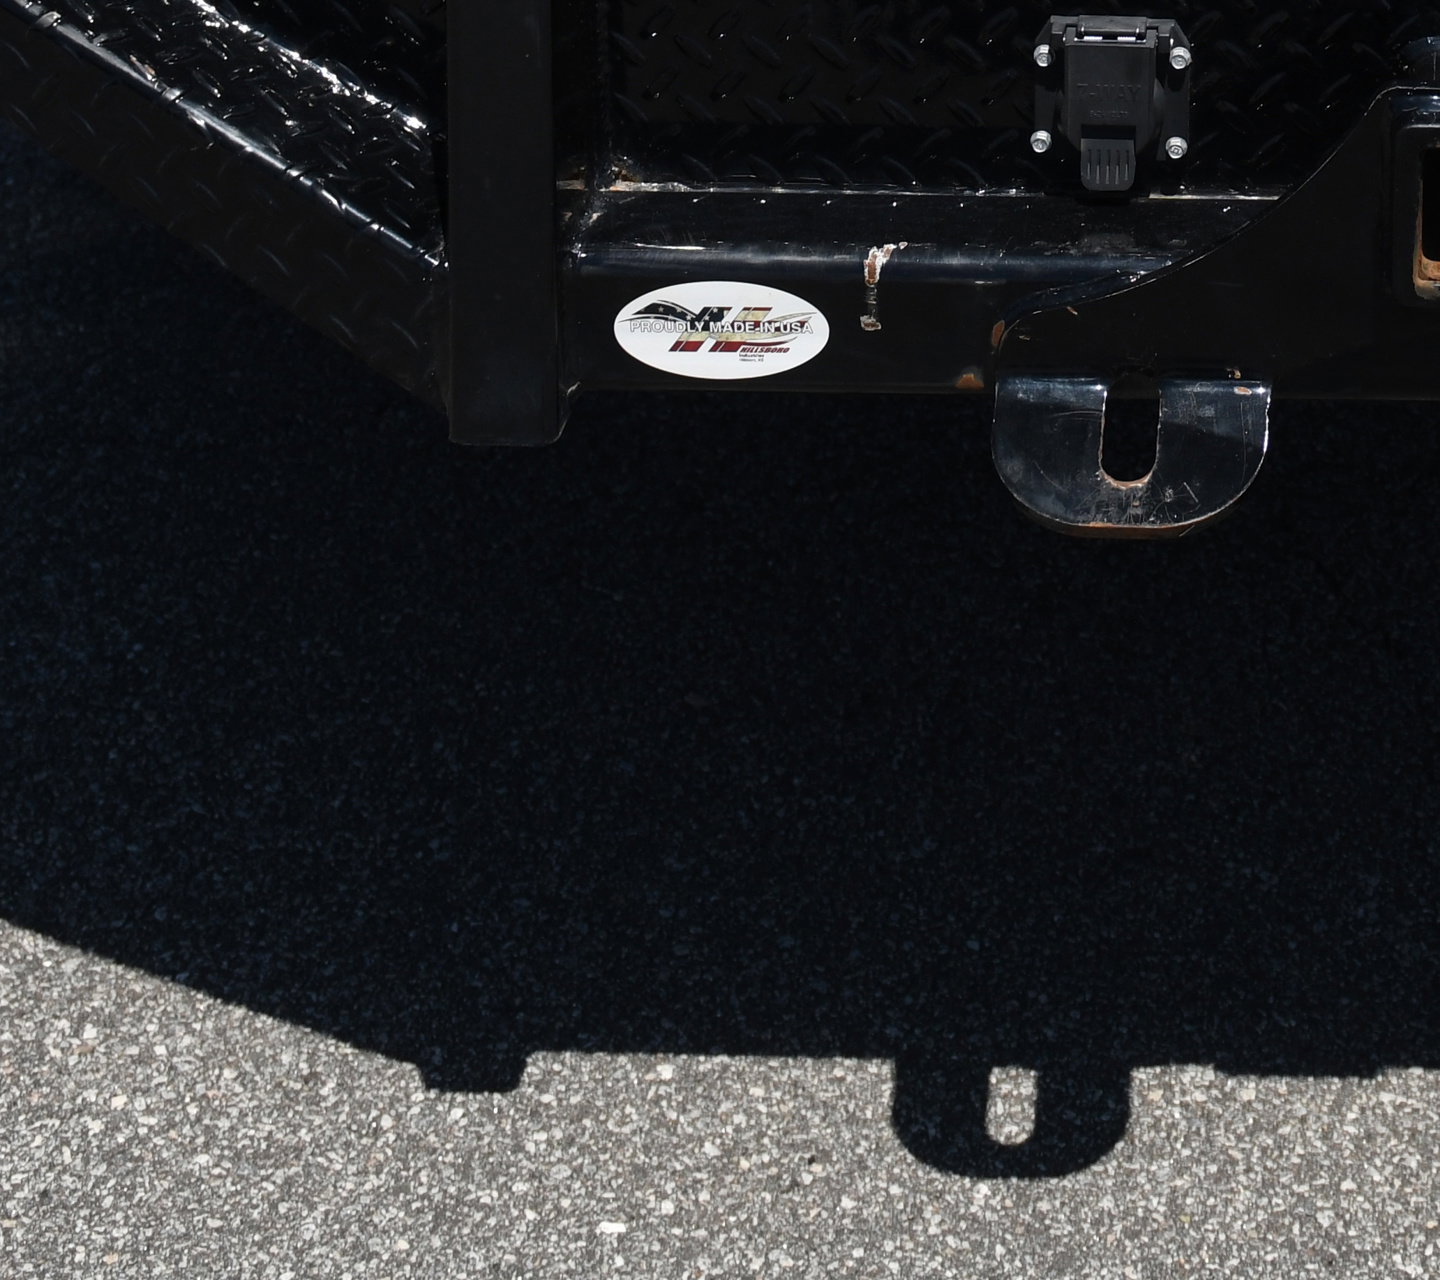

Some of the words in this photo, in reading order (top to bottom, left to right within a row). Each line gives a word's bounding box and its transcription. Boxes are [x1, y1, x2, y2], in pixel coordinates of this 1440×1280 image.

[630, 320, 705, 334] PROUDLY
[709, 321, 755, 334] MADE
[759, 321, 776, 334] IN
[781, 321, 814, 335] USA
[739, 346, 791, 354] HILLSBORO
